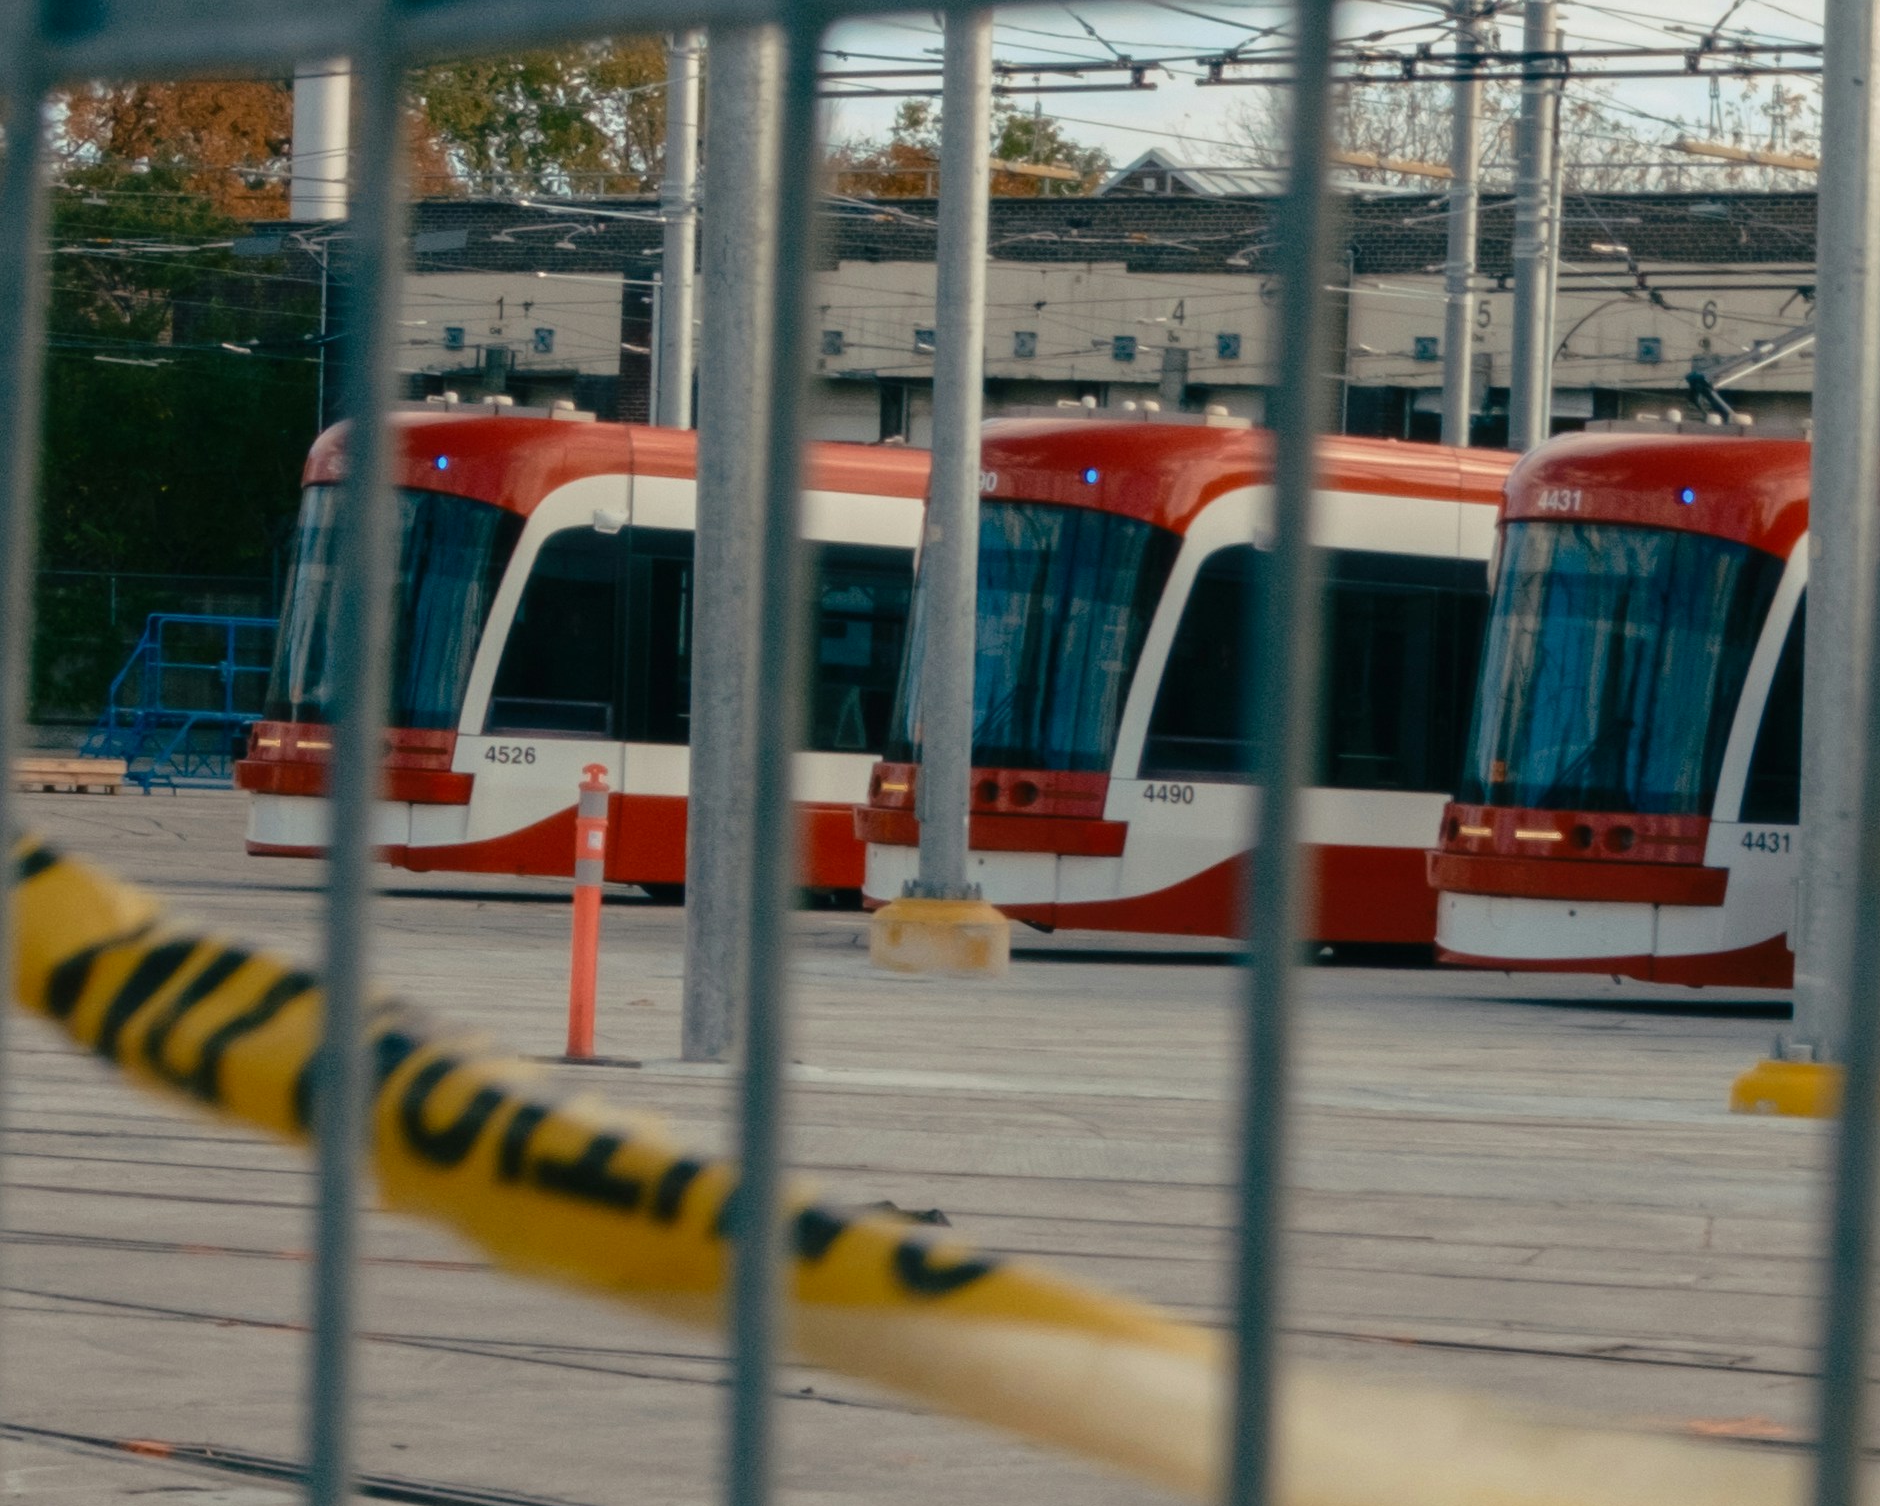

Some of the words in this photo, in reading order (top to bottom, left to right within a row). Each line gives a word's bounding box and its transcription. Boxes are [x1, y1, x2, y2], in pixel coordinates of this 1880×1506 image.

[496, 296, 505, 321] 1
[1172, 299, 1186, 326] 4
[1477, 299, 1491, 329] 5
[1702, 299, 1717, 330] 6
[1538, 489, 1583, 512] 4431
[484, 745, 536, 765] 4526
[1142, 783, 1195, 805] 4490
[1741, 831, 1790, 853] 4431
